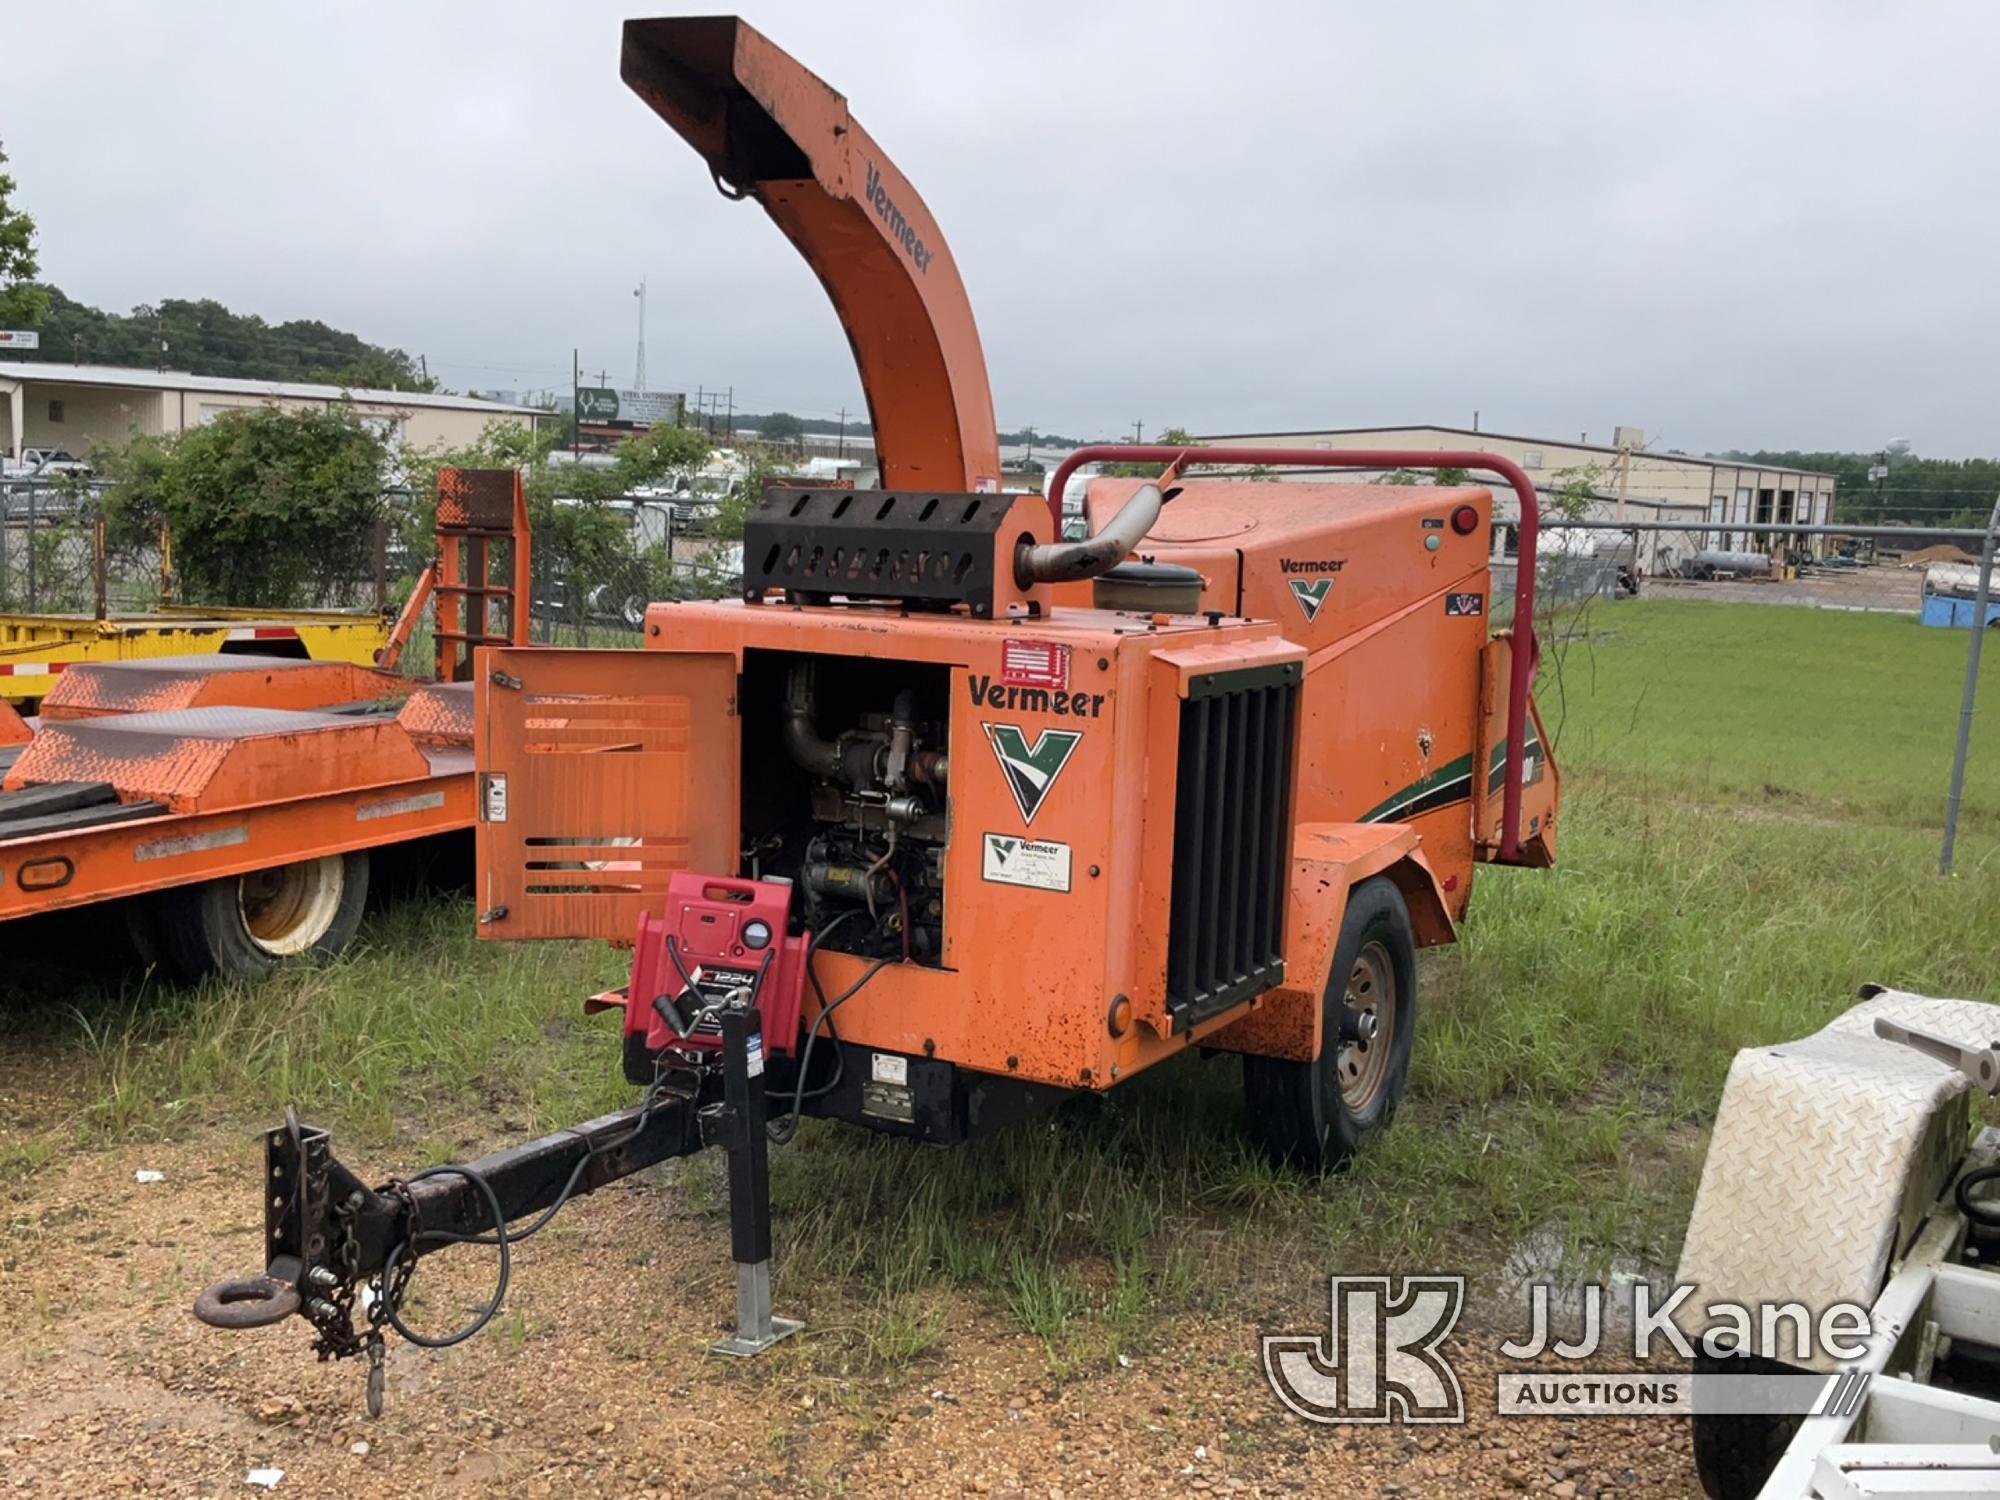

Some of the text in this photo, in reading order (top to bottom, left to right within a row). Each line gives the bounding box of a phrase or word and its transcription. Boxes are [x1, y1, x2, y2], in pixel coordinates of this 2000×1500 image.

[866, 160, 931, 275] Vermeer
[1280, 558, 1345, 574] Vermeer
[968, 673, 1105, 718] Vermeer
[1019, 840, 1059, 855] Vermeer
